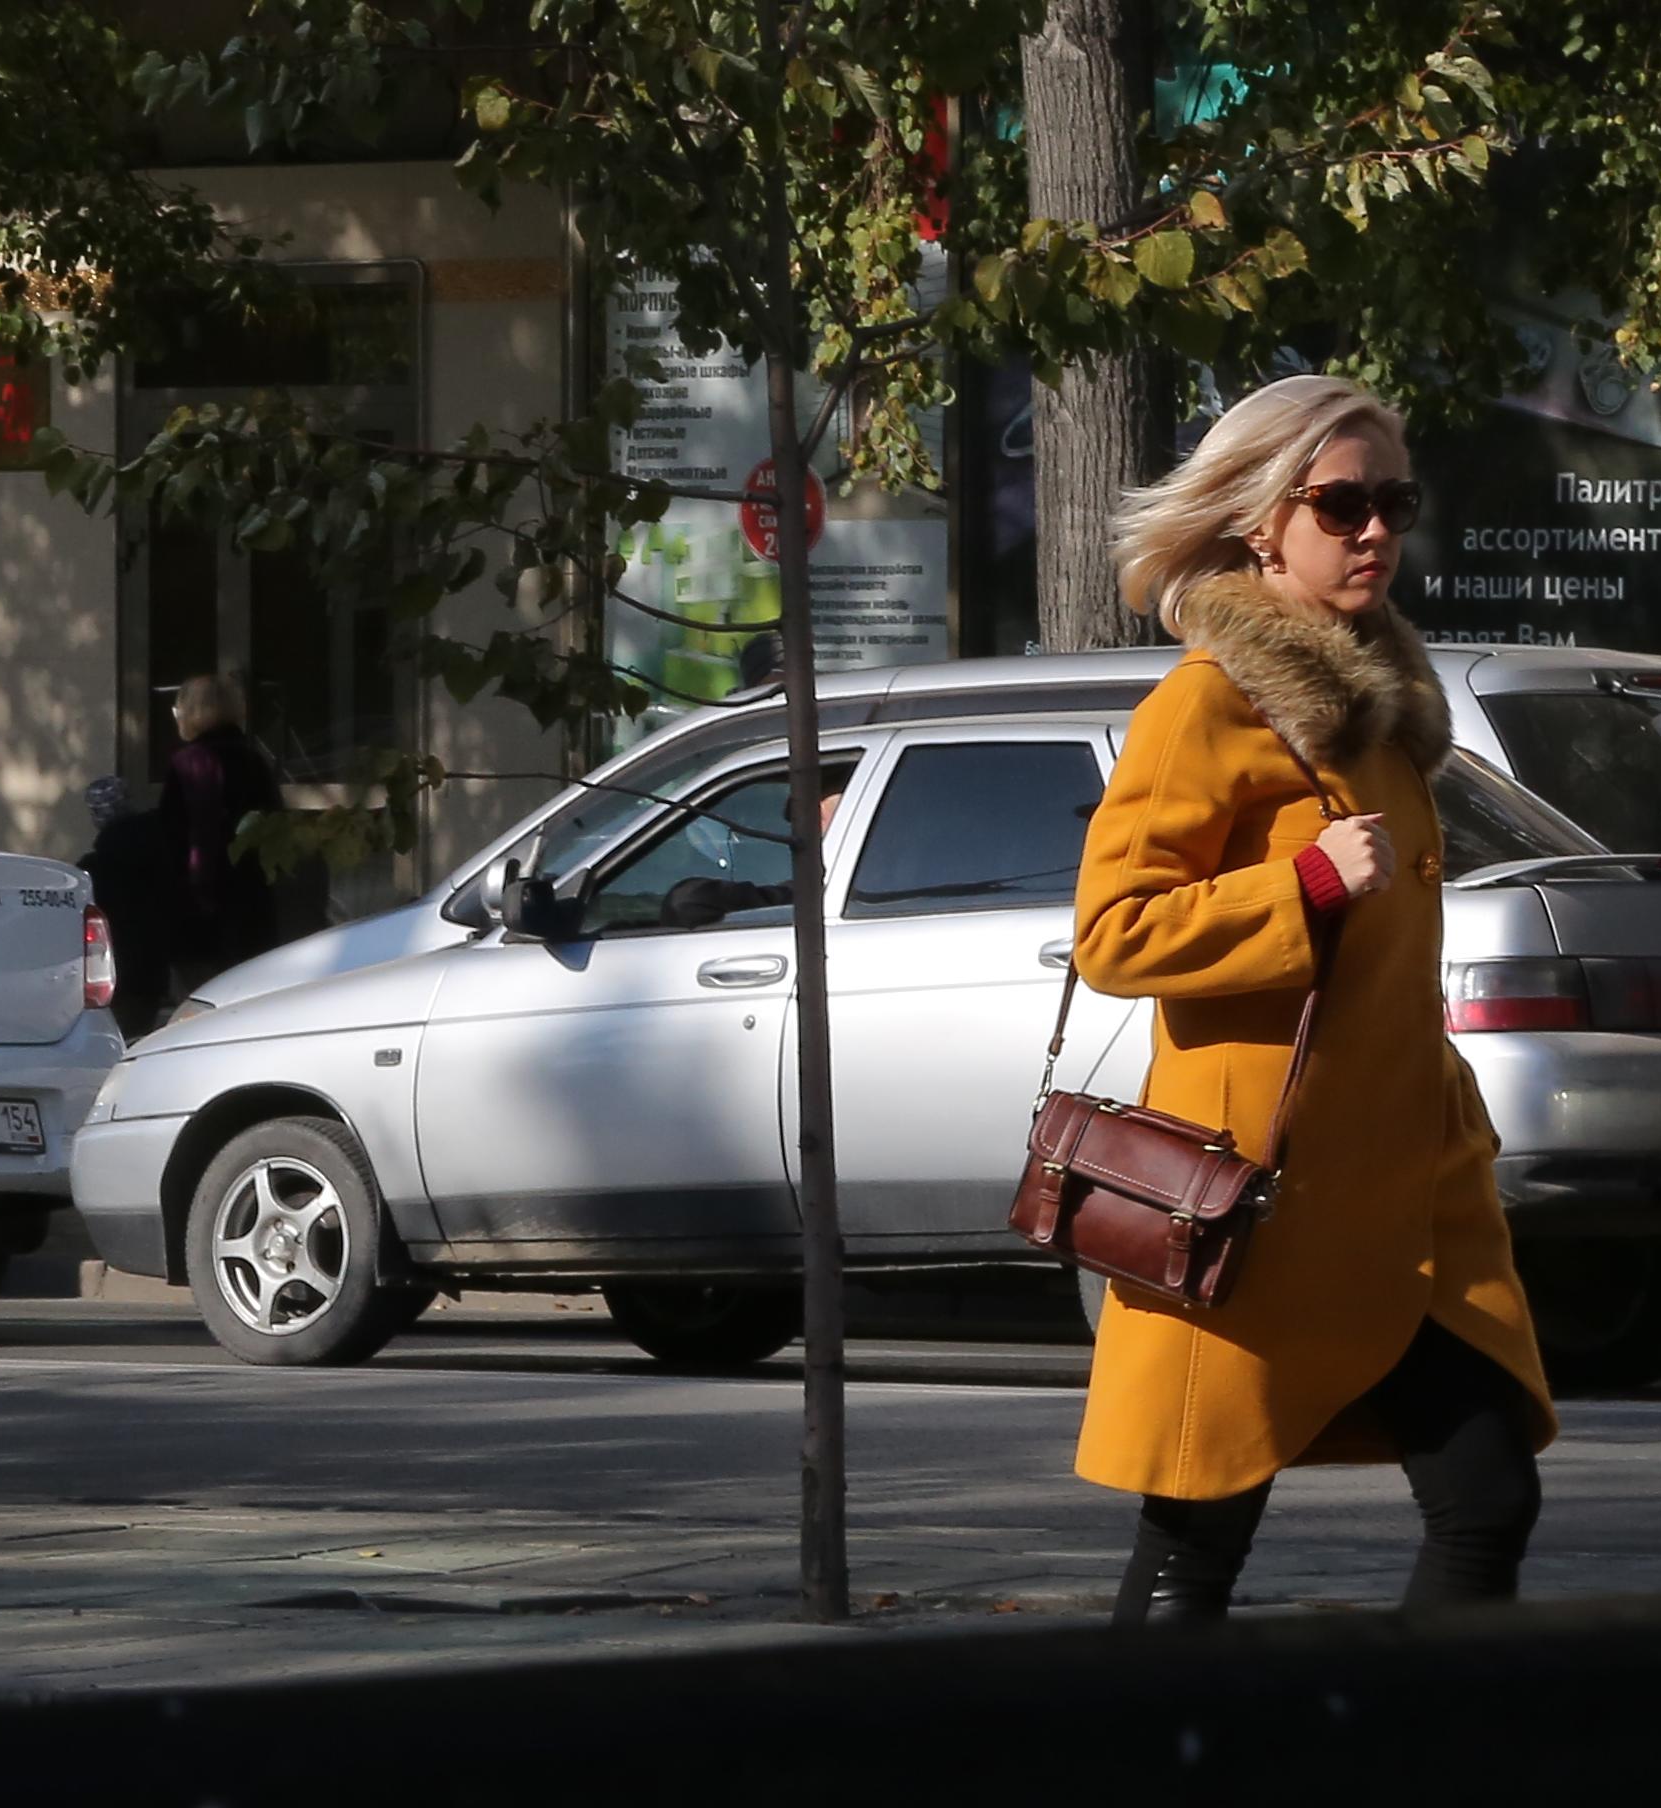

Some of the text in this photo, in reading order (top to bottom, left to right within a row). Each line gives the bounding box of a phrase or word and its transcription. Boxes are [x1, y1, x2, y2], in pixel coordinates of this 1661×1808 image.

[618, 293, 677, 312] КОРПУС
[1424, 575, 1625, 606] и наши цены
[1, 1105, 36, 1132] 154
